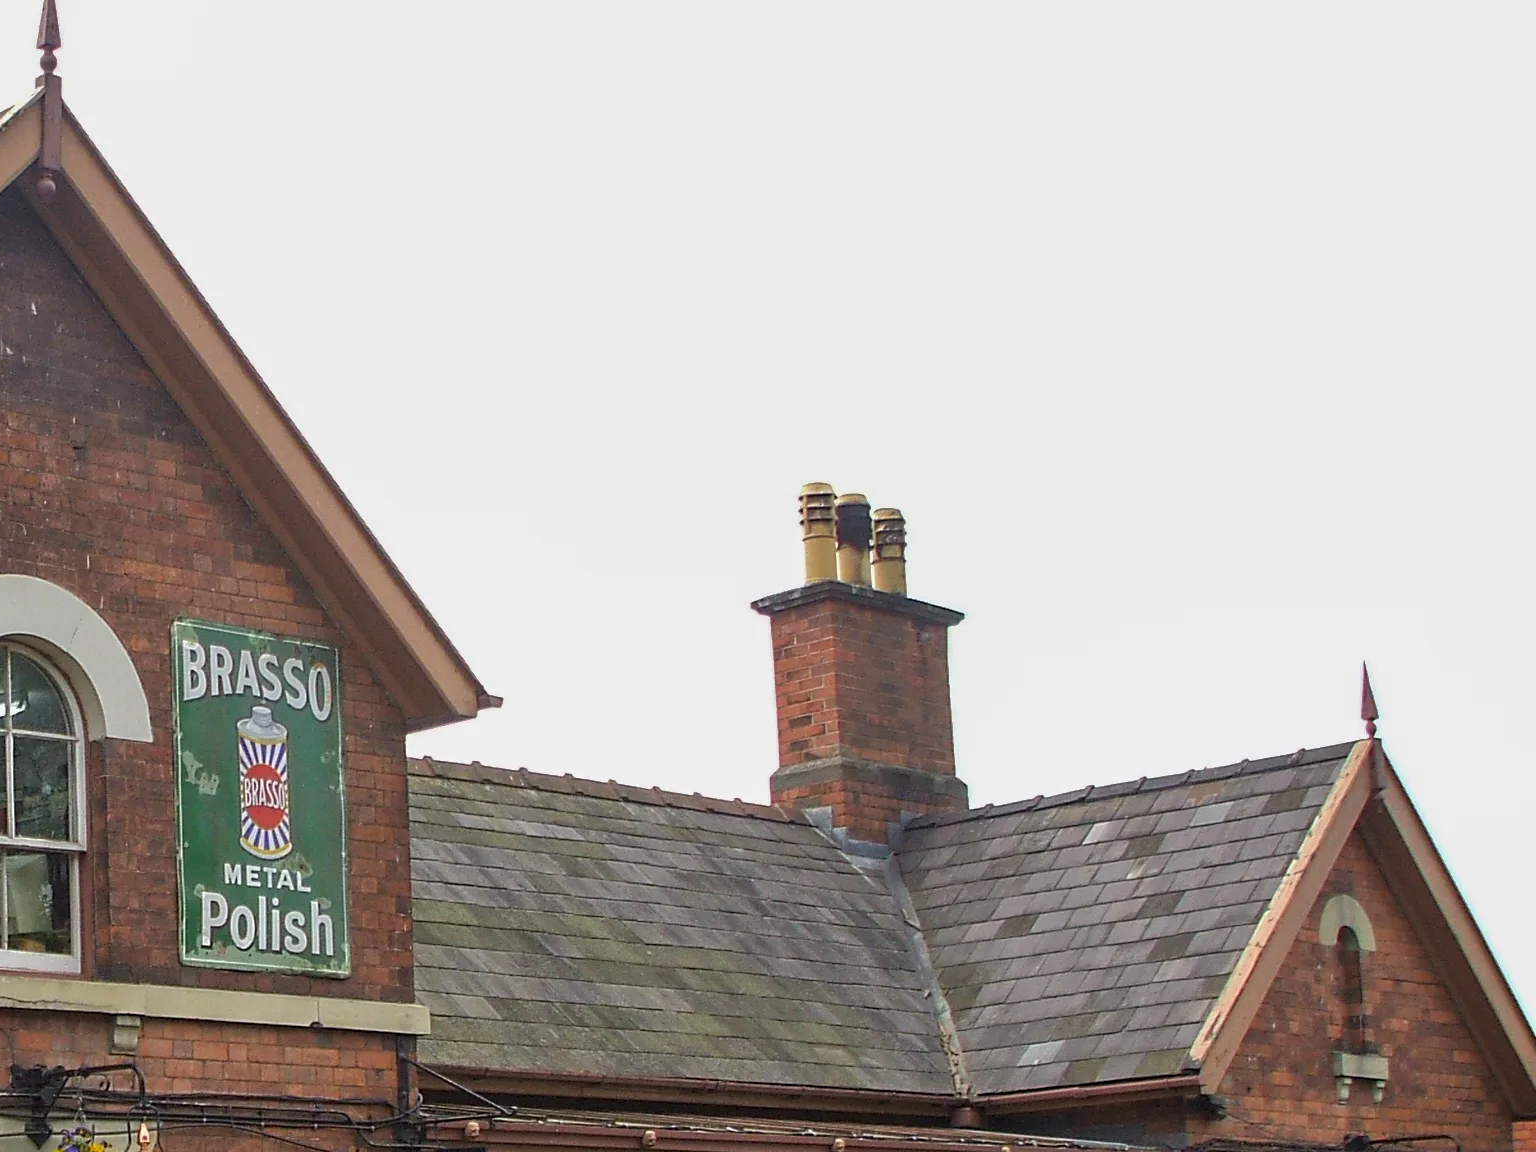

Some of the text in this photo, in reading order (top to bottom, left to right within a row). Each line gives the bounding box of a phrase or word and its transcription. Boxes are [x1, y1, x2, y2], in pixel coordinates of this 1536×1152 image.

[181, 640, 332, 721] BRASSO
[244, 778, 285, 810] BRASSO
[224, 863, 311, 893] METAL
[201, 890, 334, 957] Polish
